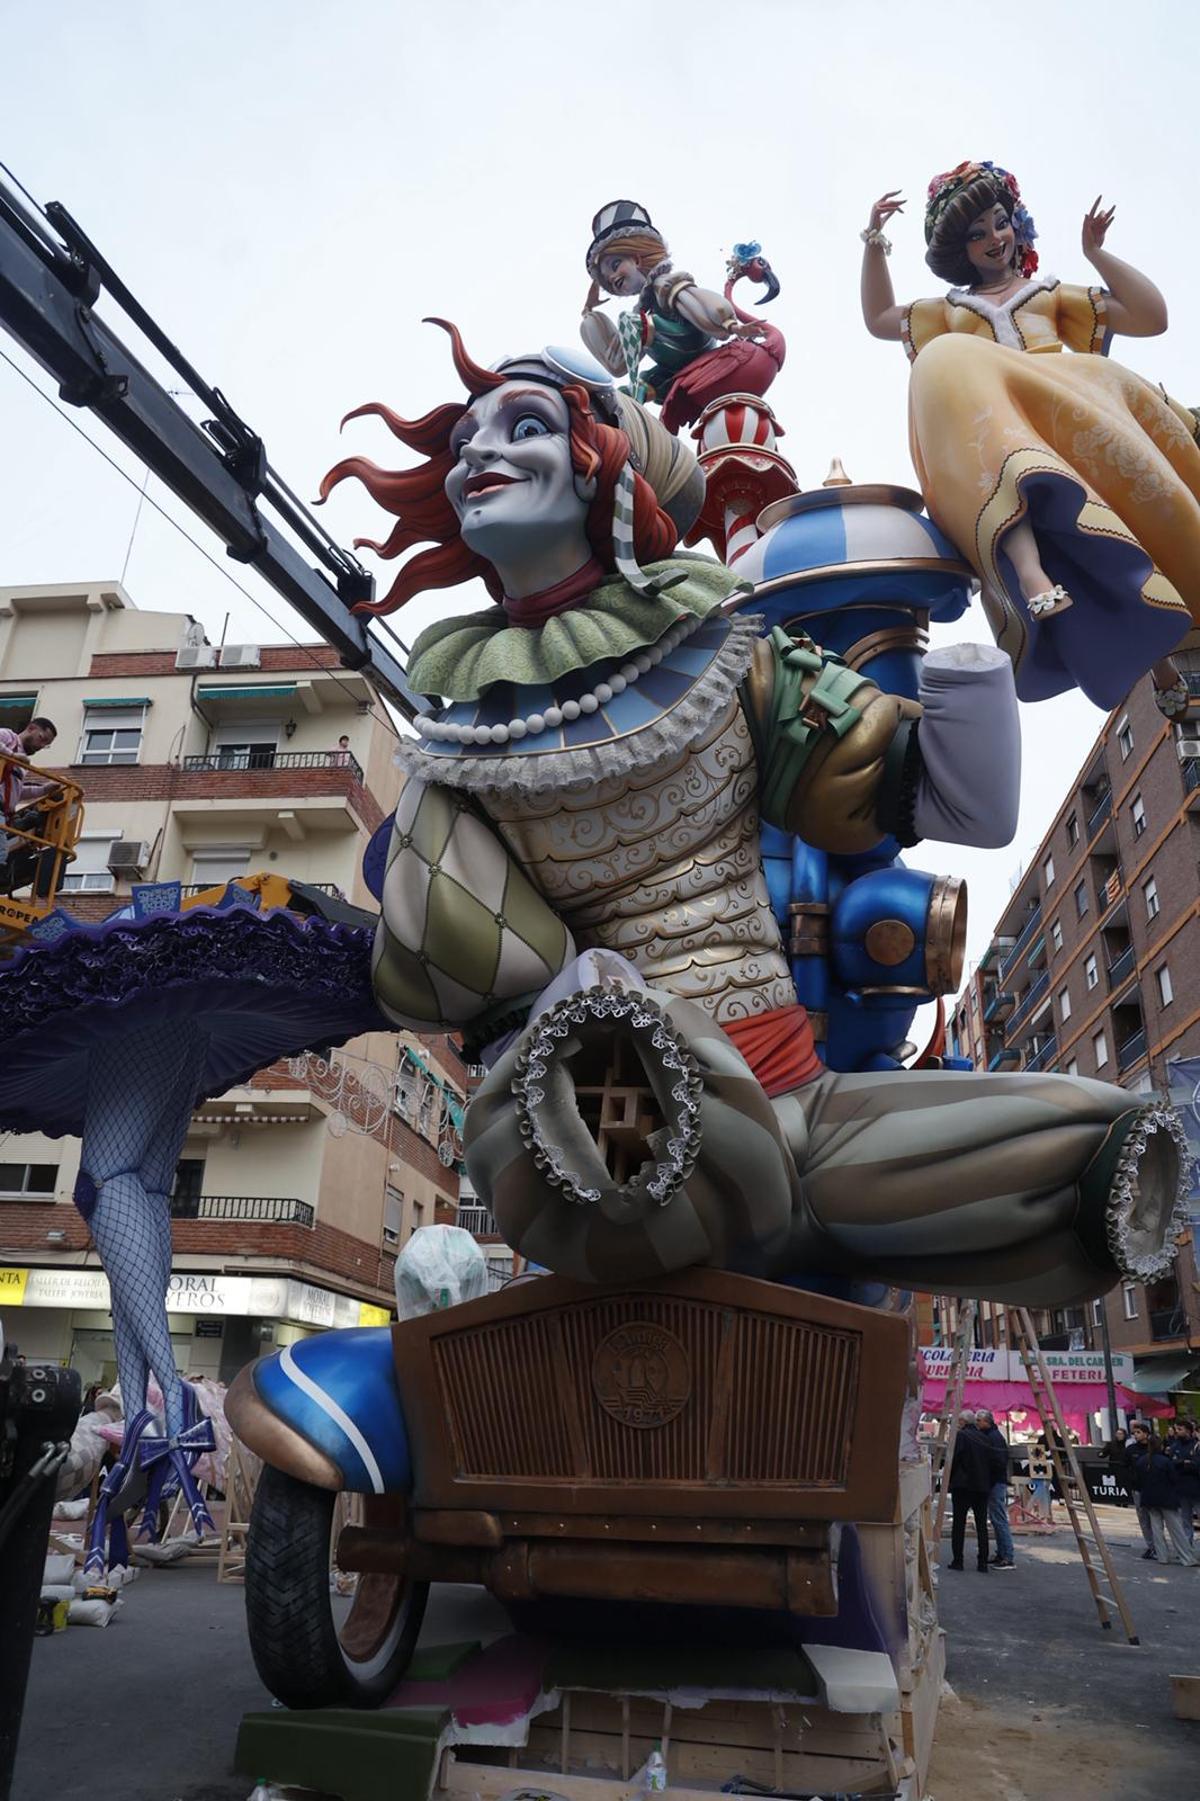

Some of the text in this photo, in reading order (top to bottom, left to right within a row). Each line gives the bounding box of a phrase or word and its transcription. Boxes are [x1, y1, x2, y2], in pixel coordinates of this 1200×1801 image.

[1068, 1357, 1085, 1366] DEL
[1086, 1357, 1123, 1367] CAREN
[1092, 1486, 1128, 1497] TURIA
